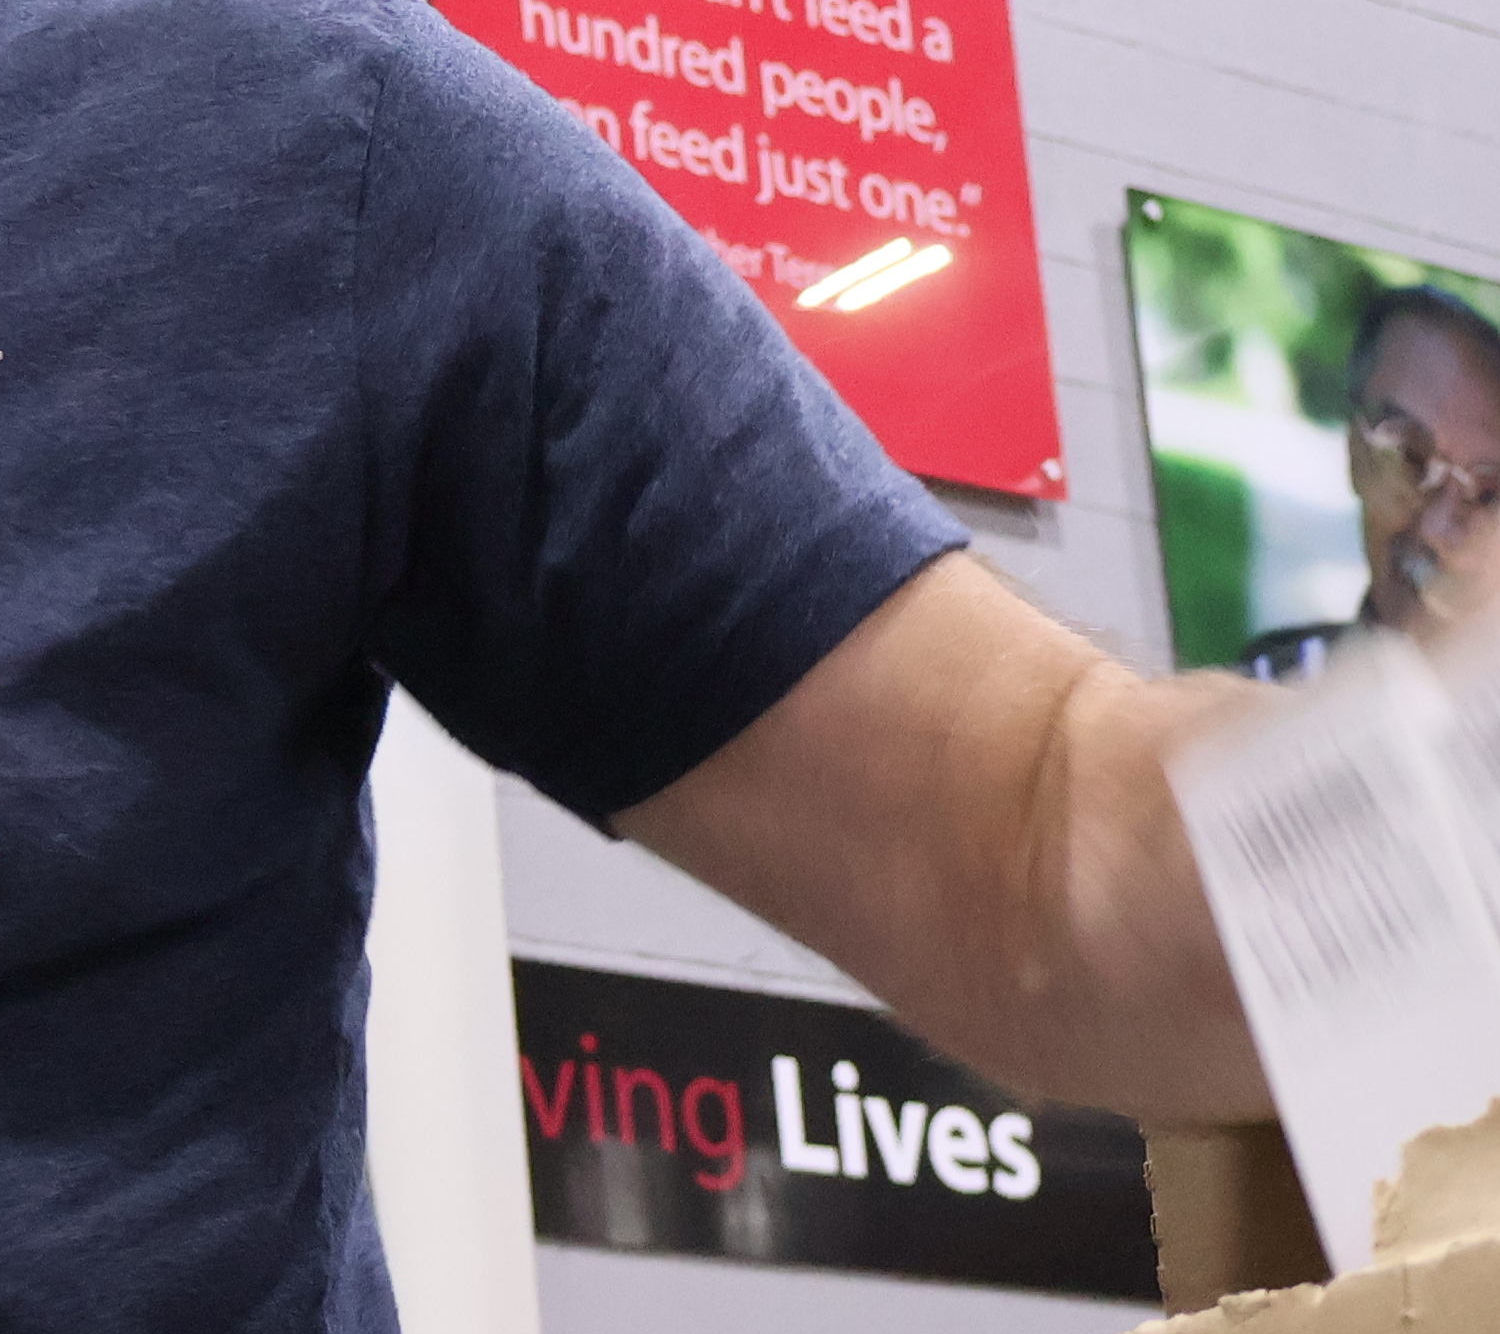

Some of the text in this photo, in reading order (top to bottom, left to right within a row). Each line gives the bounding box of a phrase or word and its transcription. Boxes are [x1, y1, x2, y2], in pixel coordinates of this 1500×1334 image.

[921, 16, 954, 62] a
[630, 99, 748, 185] feed
[755, 132, 853, 212] just
[760, 60, 948, 154] people,
[520, 1032, 1042, 1200] ving Lives
